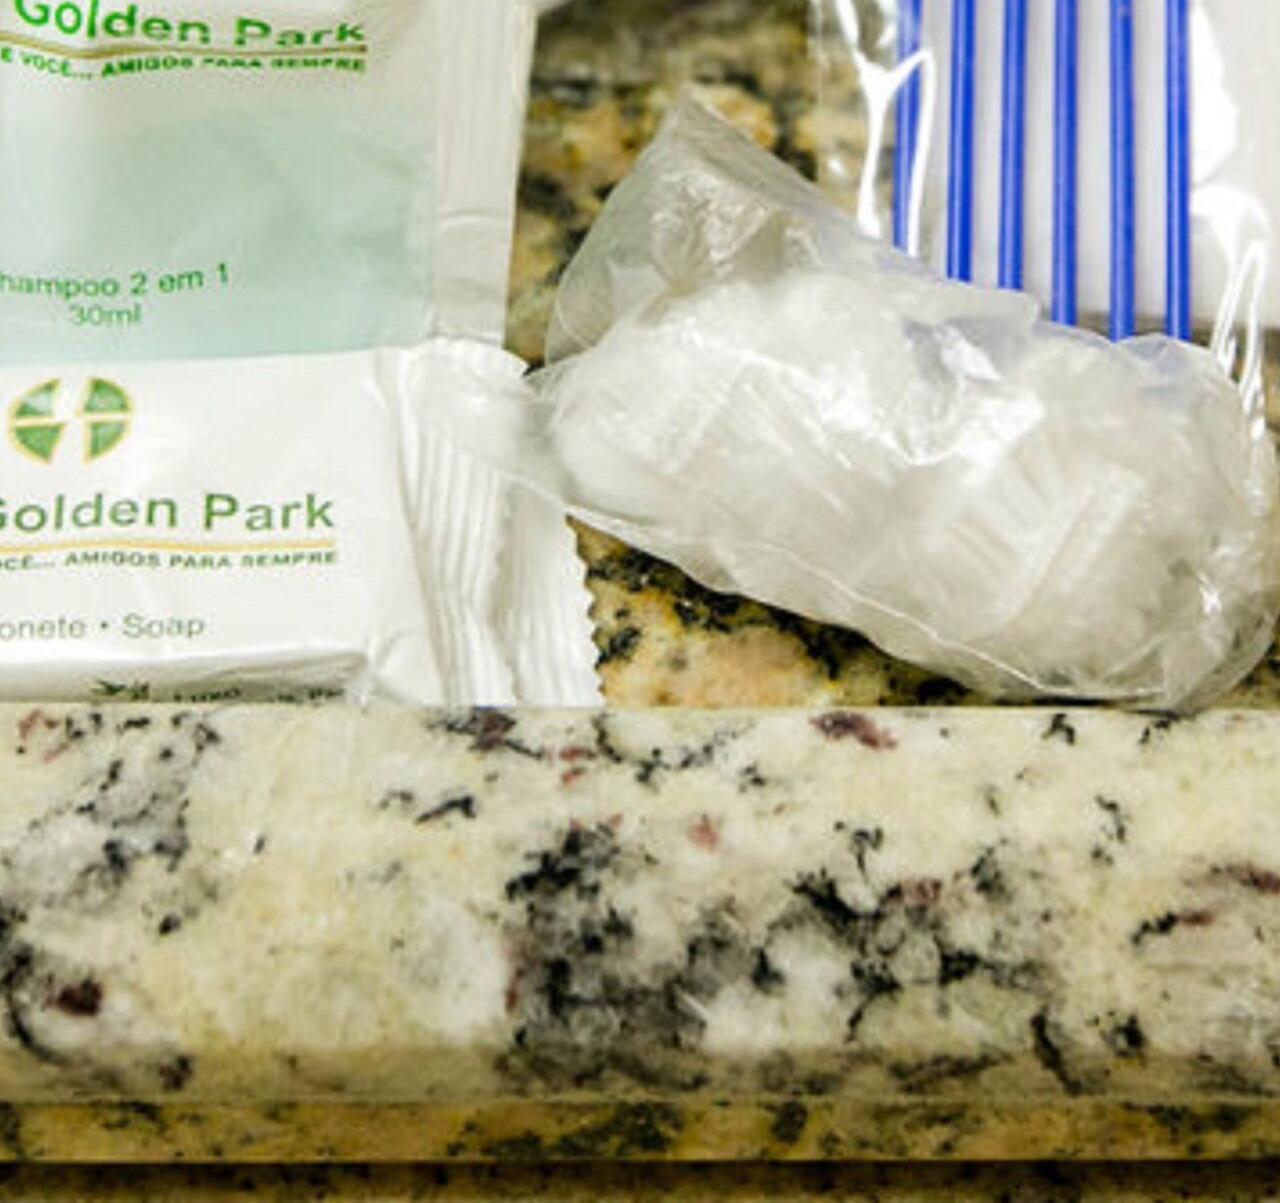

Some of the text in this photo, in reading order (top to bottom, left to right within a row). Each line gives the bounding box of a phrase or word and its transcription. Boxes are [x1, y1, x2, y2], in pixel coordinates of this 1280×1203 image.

[235, 17, 365, 46] Park
[0, 47, 12, 63] E
[101, 56, 194, 77] AMIGOS
[273, 57, 365, 72] SEMPRE
[130, 271, 148, 294] 2
[158, 266, 204, 293] em
[216, 262, 229, 284] 1
[68, 303, 141, 326] 30ml
[202, 493, 335, 532] Park
[64, 551, 161, 568] AMIGOS
[168, 554, 231, 569] PARA
[241, 550, 338, 568] SEMPRE
[122, 612, 206, 640] Soap
